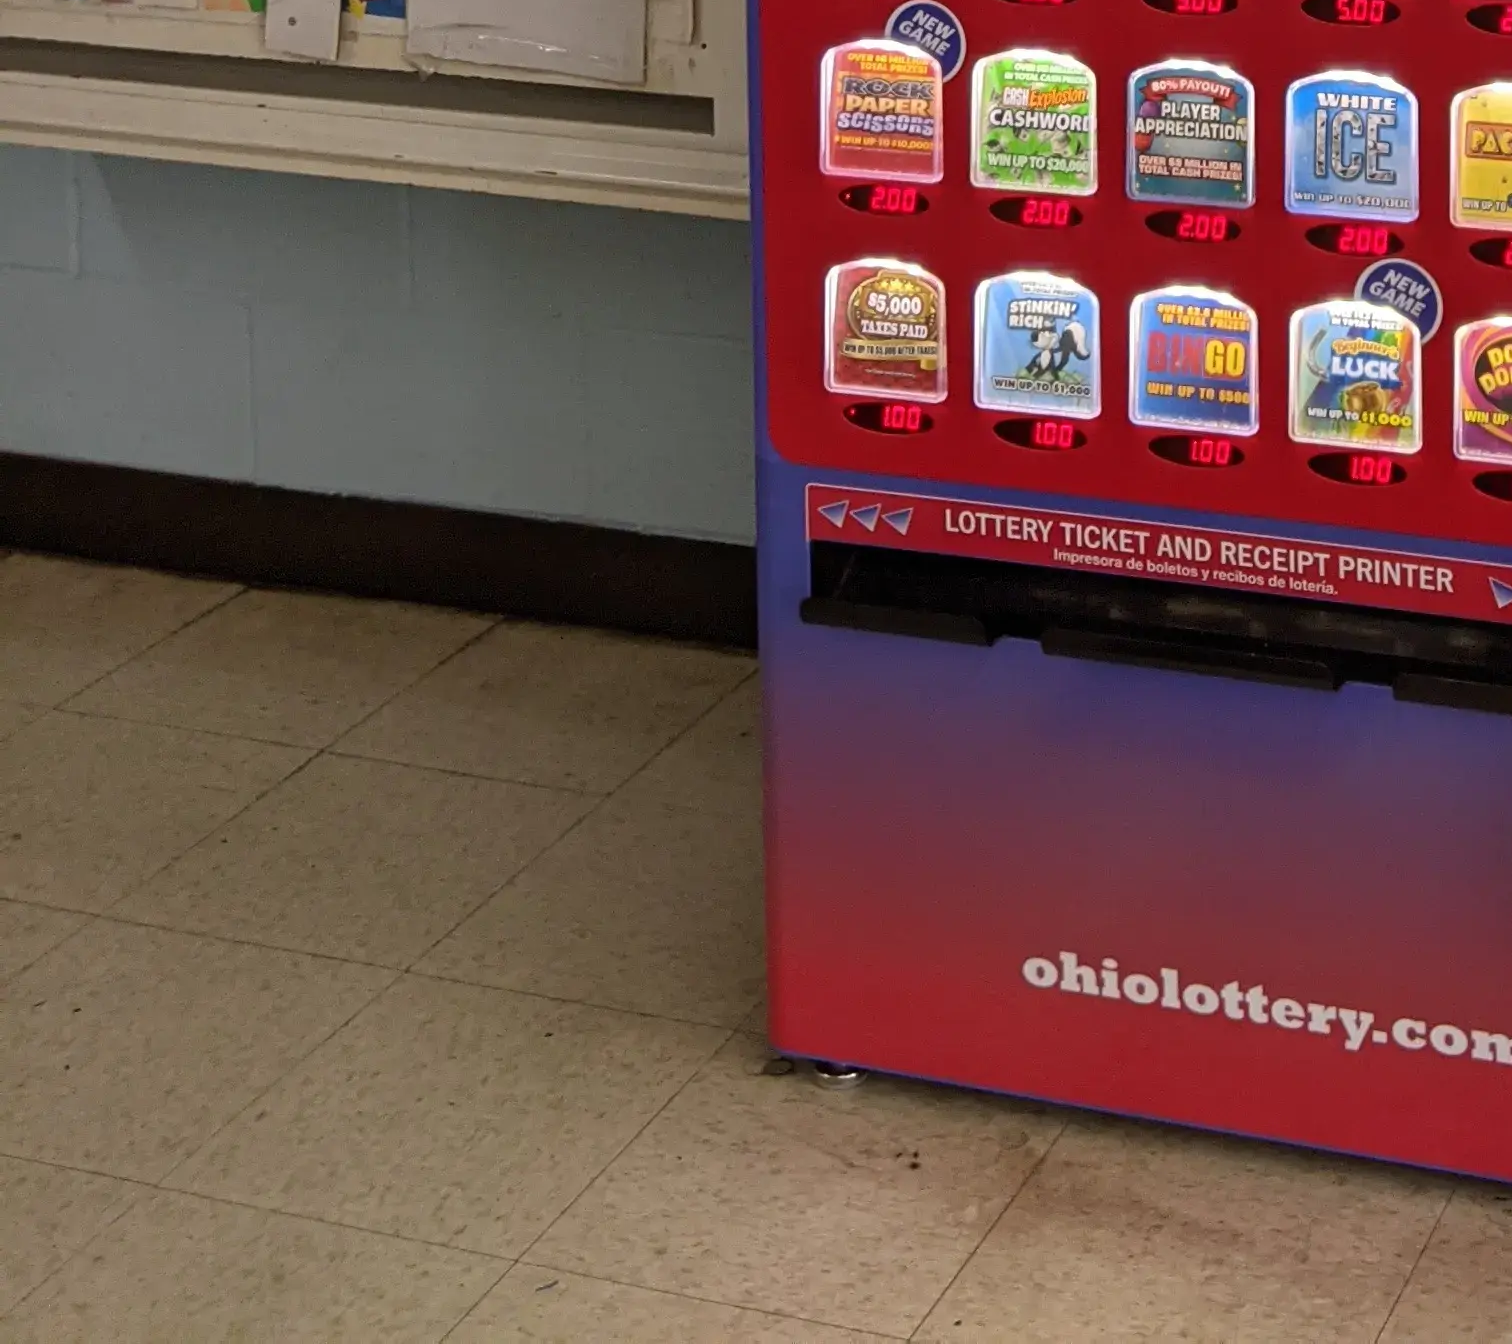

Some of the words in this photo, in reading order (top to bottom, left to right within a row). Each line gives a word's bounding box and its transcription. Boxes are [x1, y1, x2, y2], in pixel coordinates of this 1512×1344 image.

[1313, 109, 1397, 185] ICE
[945, 509, 1053, 542] LOTTERY
[1059, 521, 1151, 556] TICKET
[1157, 536, 1212, 561] AND
[1219, 540, 1331, 577] RECEIPT
[1338, 556, 1454, 593] PRINTER
[1053, 548, 1123, 571] Impresora
[1126, 556, 1143, 570] de
[1148, 558, 1198, 578] boletos
[1213, 568, 1266, 587] recibos
[1268, 573, 1286, 588] de
